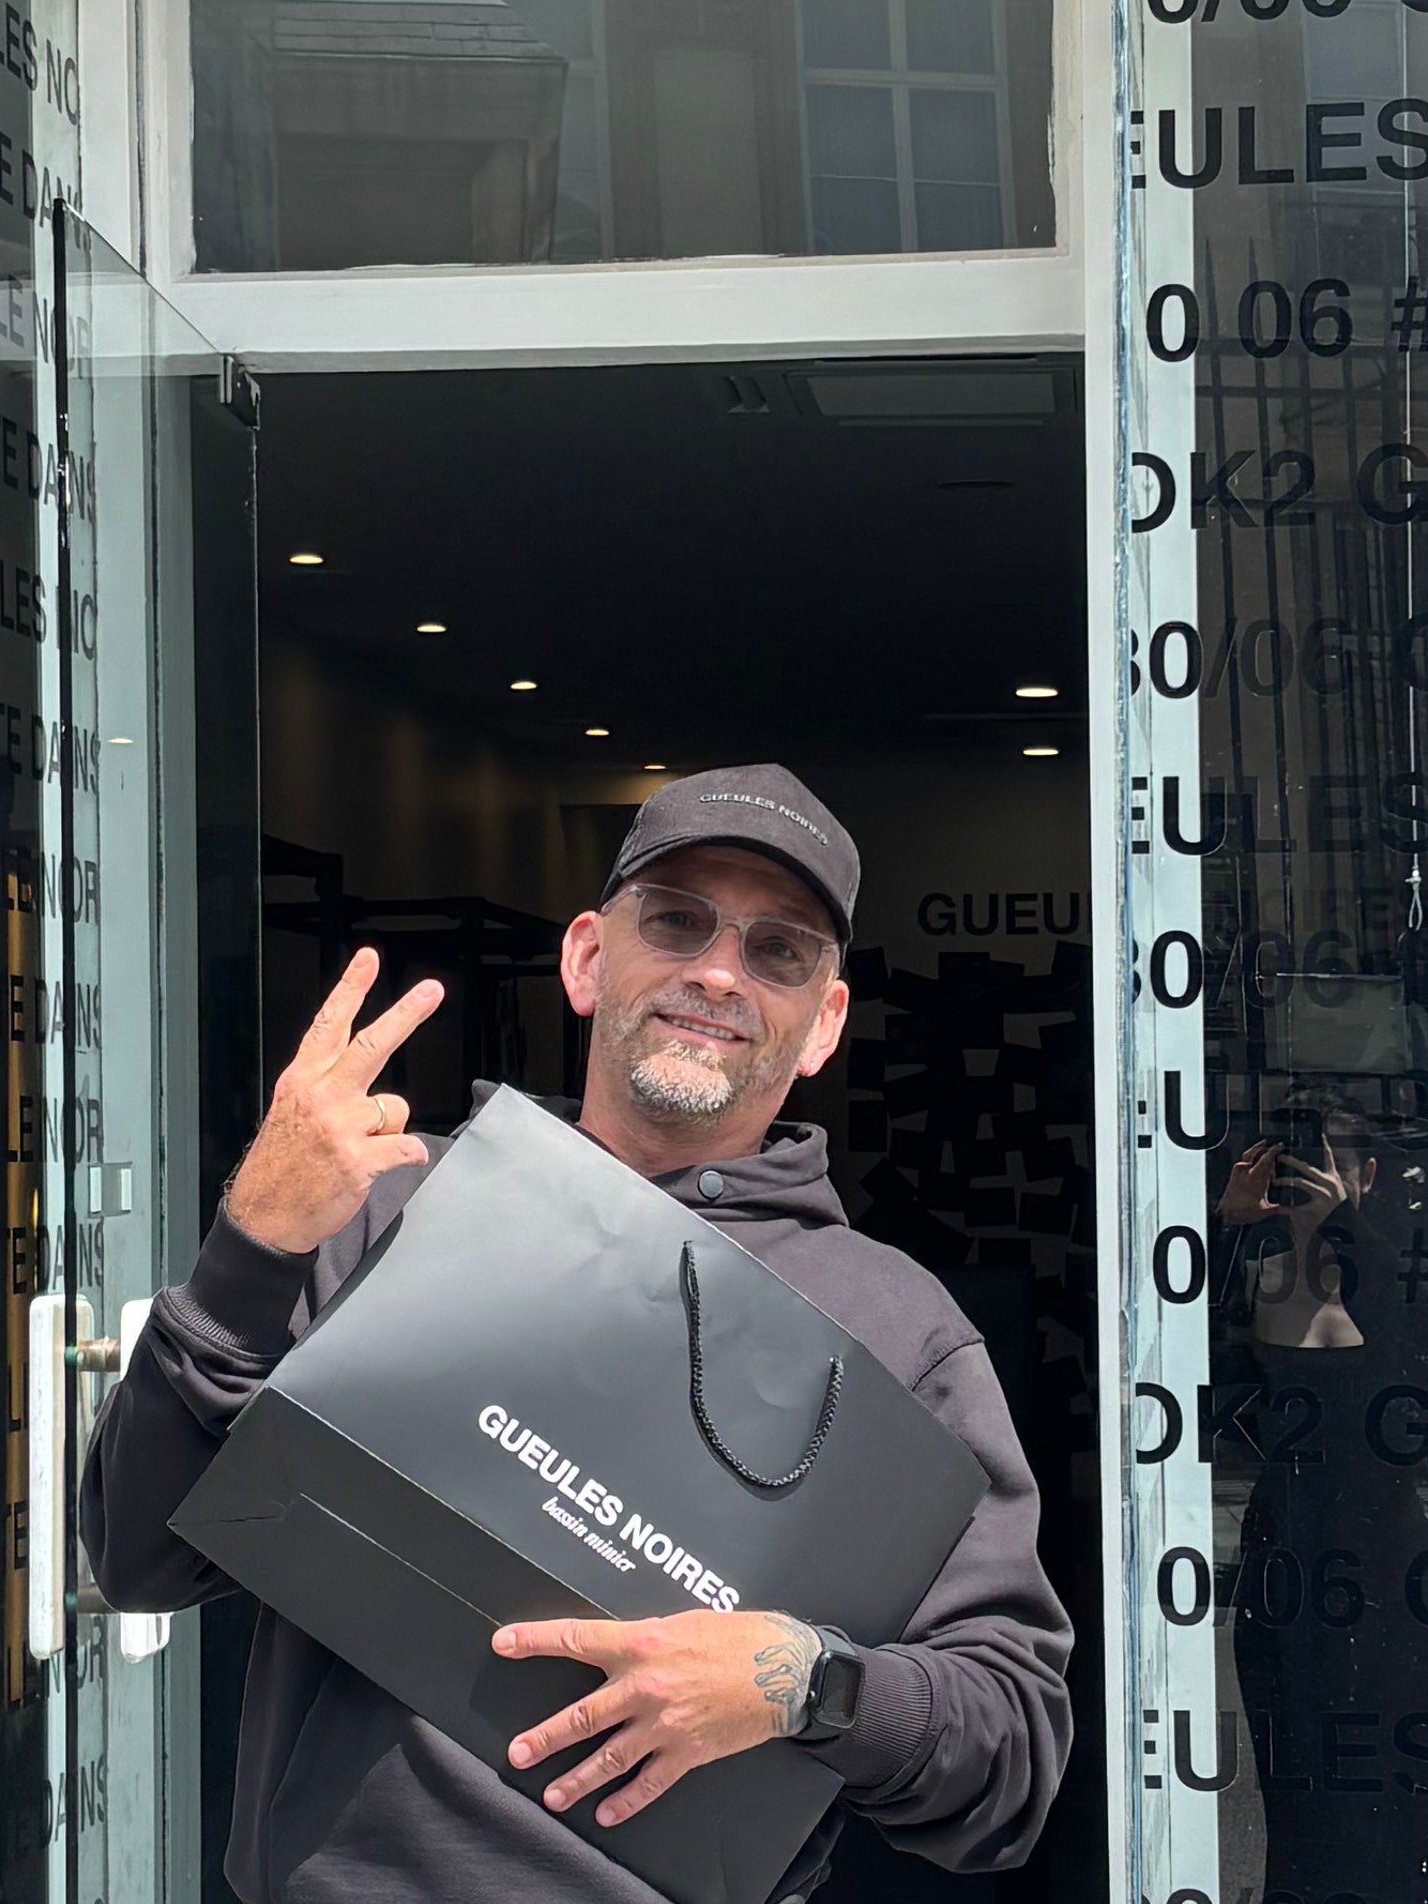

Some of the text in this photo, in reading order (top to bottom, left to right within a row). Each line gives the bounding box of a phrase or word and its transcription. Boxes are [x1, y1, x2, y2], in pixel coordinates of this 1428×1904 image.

[1238, 277, 1354, 360] 06
[700, 793, 828, 846] GUEULES NOIRES
[918, 892, 1093, 936] GUEU
[478, 1405, 740, 1613] GUEULES NOIRES
[542, 1496, 636, 1573] bassin minier
